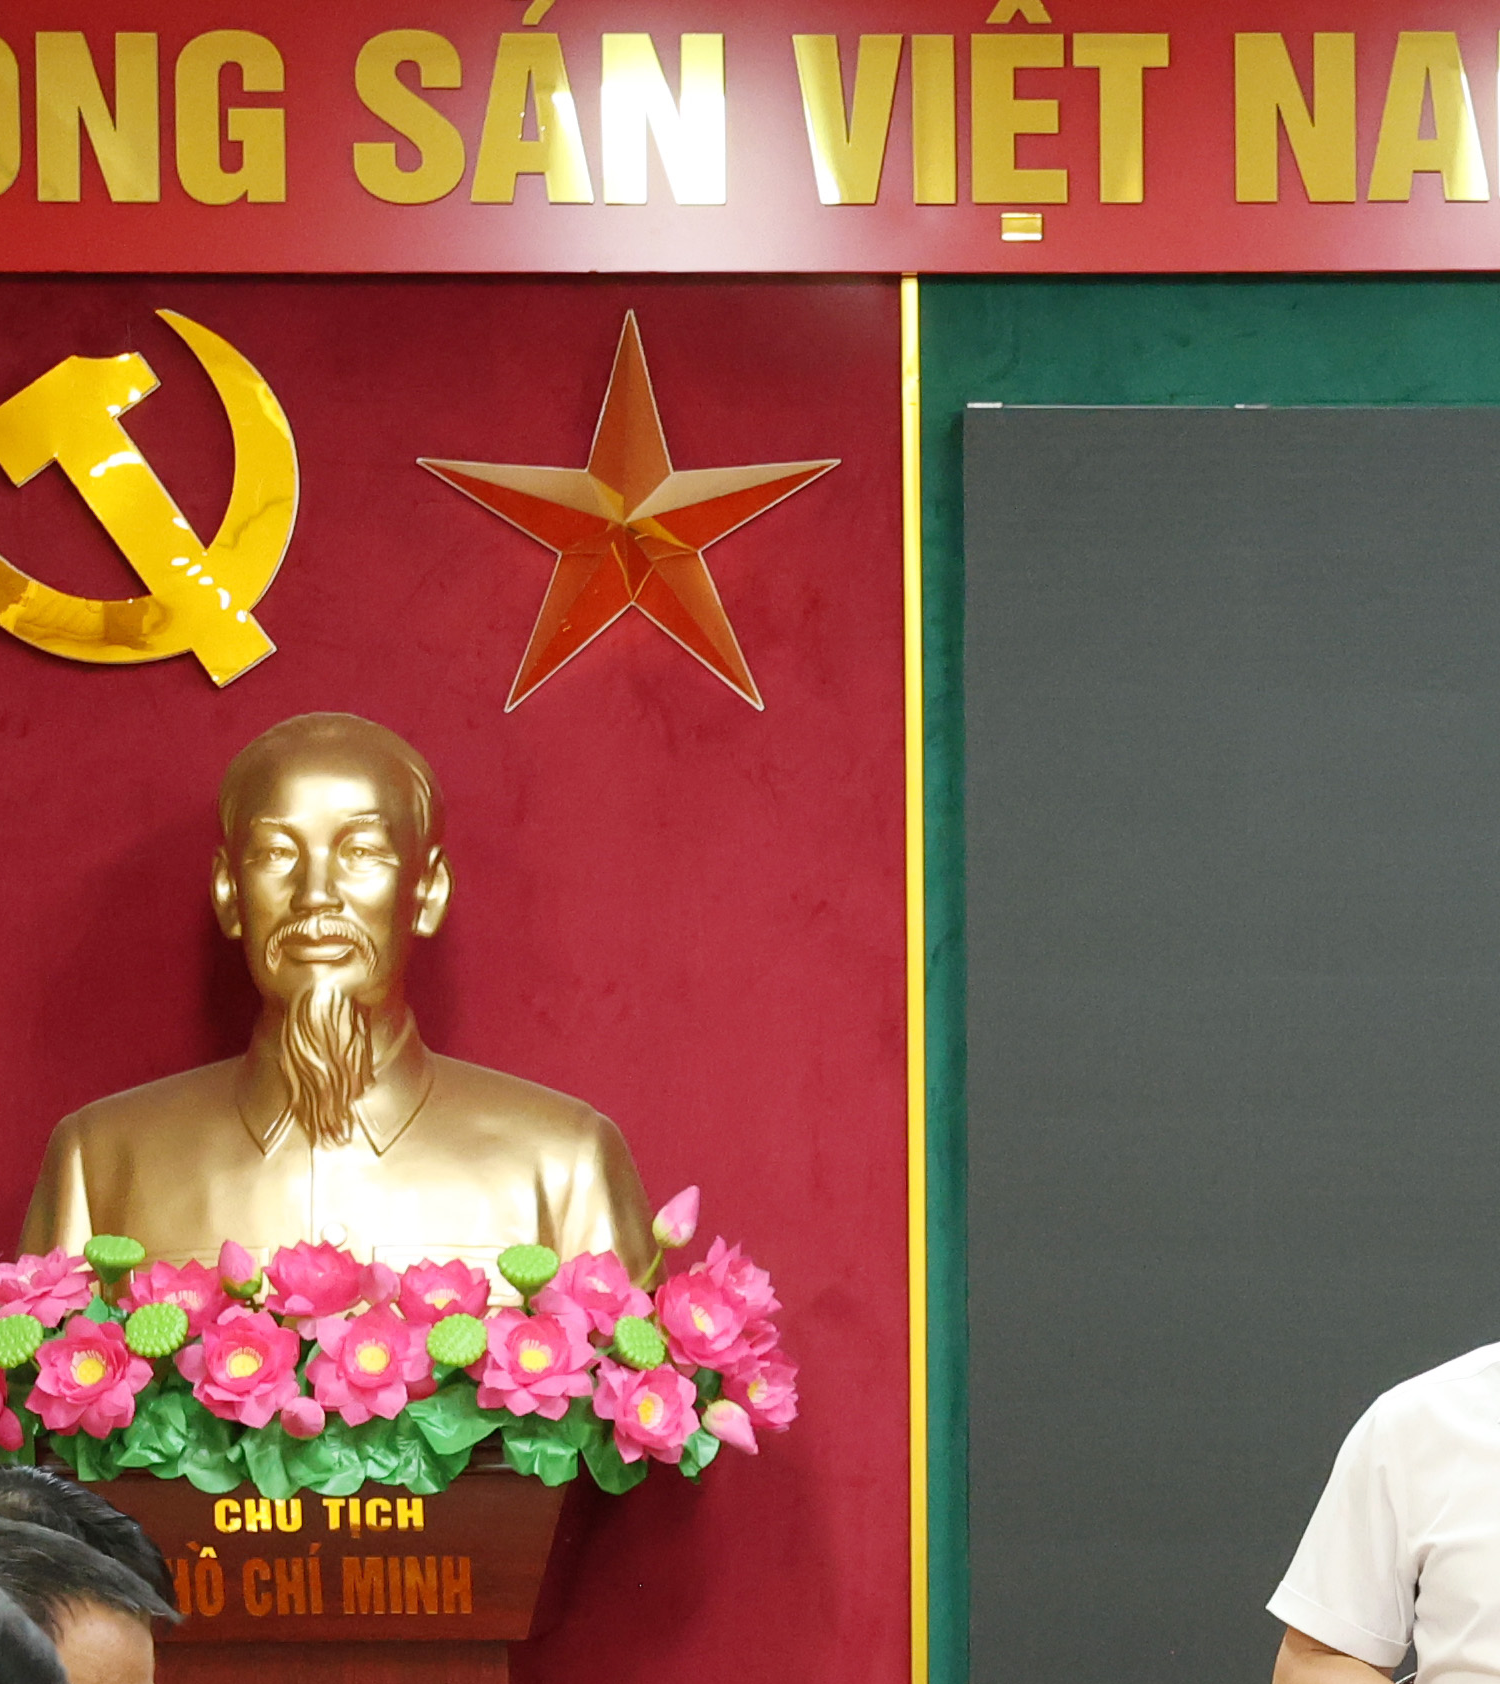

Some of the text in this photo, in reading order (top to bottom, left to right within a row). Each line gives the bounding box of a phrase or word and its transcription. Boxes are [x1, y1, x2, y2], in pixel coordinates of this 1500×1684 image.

[791, 0, 1170, 242] VIỆT
[322, 1498, 425, 1539] TỊCH
[242, 1542, 324, 1617] CHÍ
[342, 1556, 474, 1615] MINH
